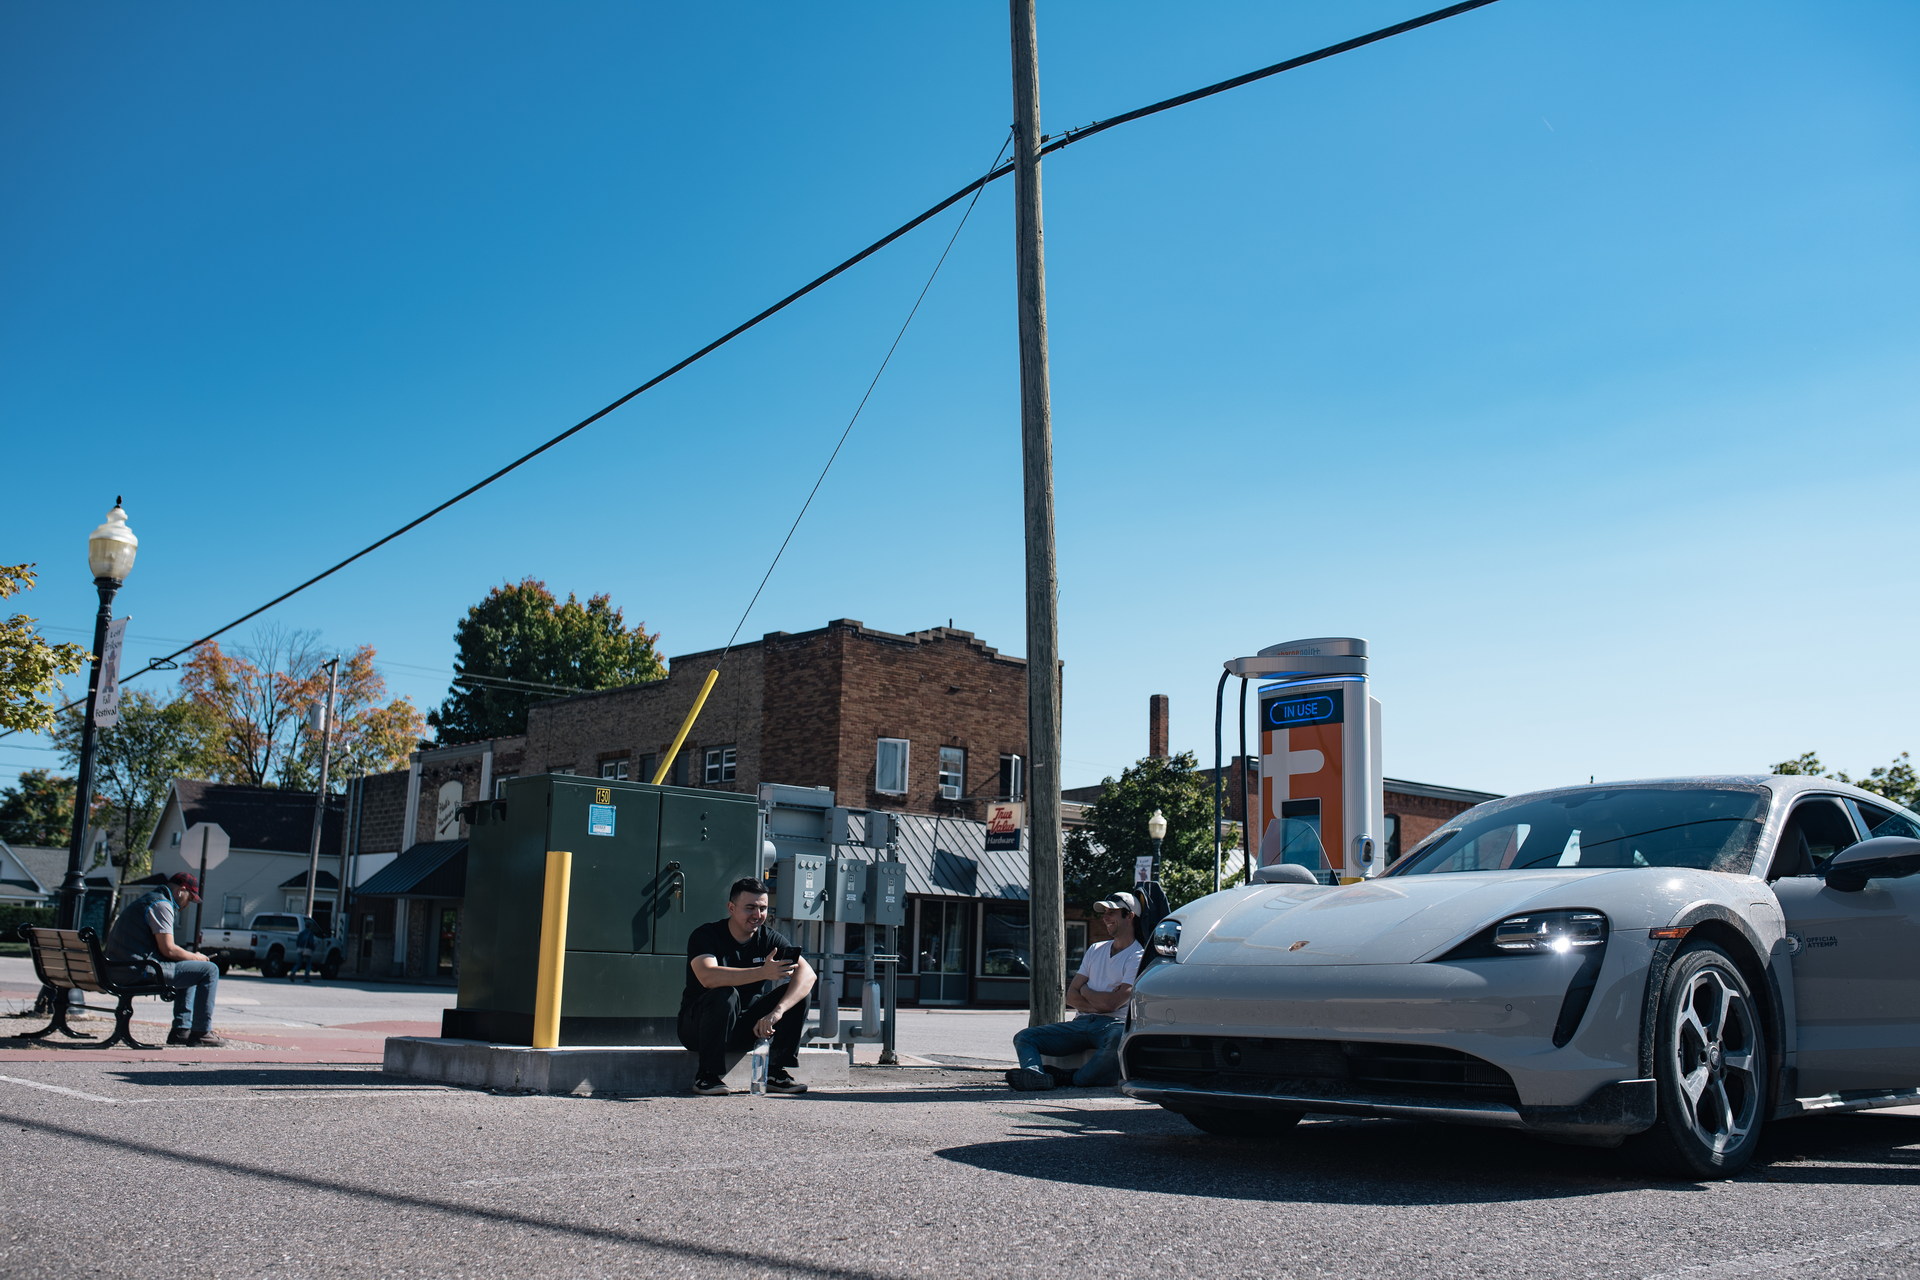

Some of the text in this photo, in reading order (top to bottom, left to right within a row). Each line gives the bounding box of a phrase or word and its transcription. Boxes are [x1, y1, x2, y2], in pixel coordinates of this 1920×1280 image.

[102, 694, 111, 705] Fall
[95, 705, 117, 718] Festival
[1284, 702, 1318, 718] IN USE
[597, 790, 609, 803] 150
[994, 807, 1012, 820] True
[988, 820, 1015, 834] Value
